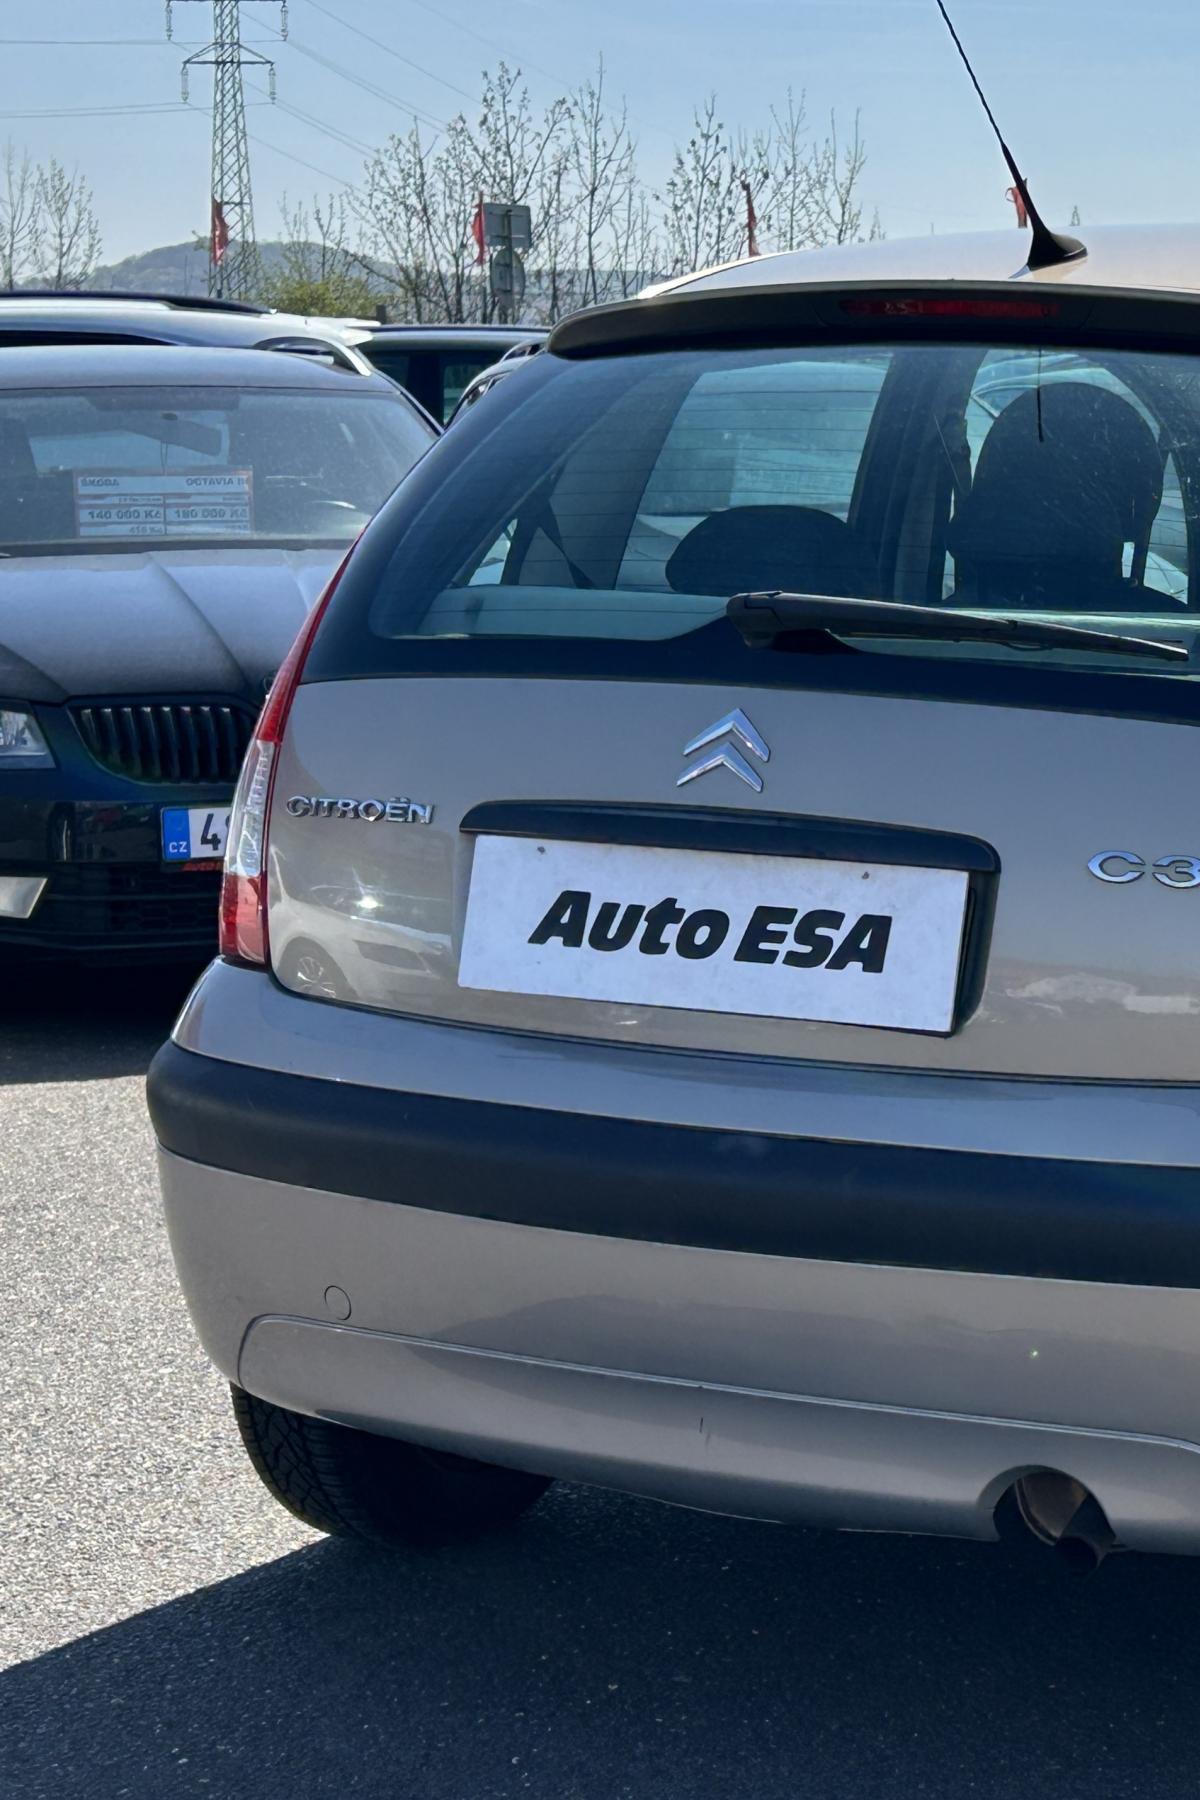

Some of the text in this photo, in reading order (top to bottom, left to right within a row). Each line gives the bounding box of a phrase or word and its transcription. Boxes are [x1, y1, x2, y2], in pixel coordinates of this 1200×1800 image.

[186, 477, 234, 486] OCTAVIA
[88, 510, 112, 520] 140
[116, 509, 141, 520] 000
[201, 508, 226, 518] 000
[286, 796, 433, 824] CITROËN
[200, 813, 230, 851] 4
[169, 841, 188, 853] CZ
